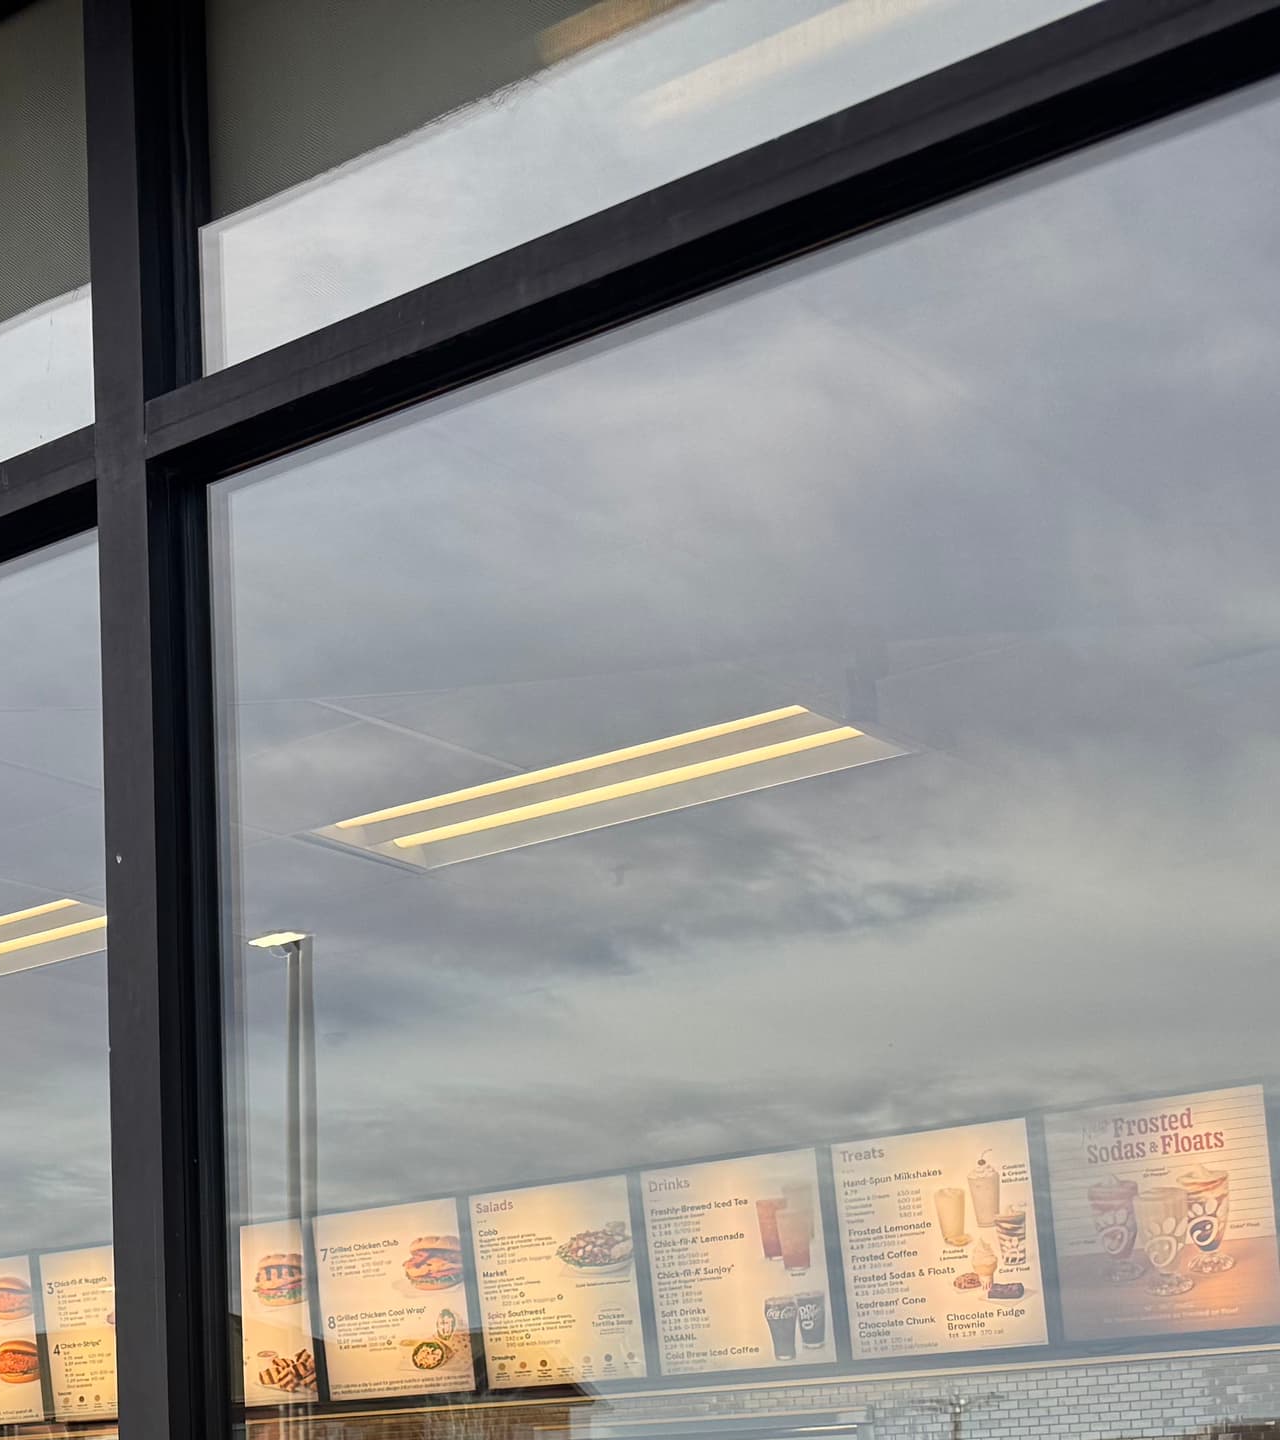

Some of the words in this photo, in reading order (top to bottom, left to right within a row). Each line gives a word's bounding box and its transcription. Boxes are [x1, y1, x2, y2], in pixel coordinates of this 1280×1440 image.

[1112, 1107, 1193, 1138] Frosted
[1088, 1142, 1146, 1164] Sodas
[1150, 1142, 1159, 1153] &
[1160, 1131, 1225, 1155] Floats
[840, 1148, 885, 1163] Treats
[648, 1178, 690, 1192] Drinks
[843, 1176, 892, 1188] Hand-Spun
[894, 1168, 942, 1180] Milkshakes
[476, 1200, 514, 1214] Salads
[650, 1203, 712, 1216] Freshly-Brewed
[714, 1199, 732, 1209] Iced
[734, 1198, 748, 1206] Tea
[479, 1229, 498, 1237] Cobb
[849, 1226, 881, 1237] Frosted
[885, 1221, 932, 1233] Lemonade
[700, 1231, 744, 1243] Lemonade
[320, 1248, 328, 1262] 7
[329, 1245, 352, 1254] Grilled
[353, 1242, 382, 1251] Chicken
[383, 1240, 399, 1249] Club
[851, 1253, 885, 1263] Frosted
[887, 1249, 918, 1260] Coffee
[483, 1270, 507, 1278] Market
[853, 1273, 887, 1283] Frosted
[889, 1271, 916, 1280] Sodas
[919, 1269, 925, 1277] &
[928, 1266, 956, 1276] Floats
[47, 1282, 54, 1295] 3
[84, 1275, 107, 1284] Nuggets
[902, 1296, 926, 1305] Cone
[328, 1316, 336, 1329] 8
[337, 1313, 359, 1322] Grilled
[360, 1310, 388, 1320] Chicken
[389, 1308, 404, 1317] Cool
[406, 1306, 425, 1316] Wrap
[487, 1311, 506, 1320] Spicy
[508, 1307, 546, 1318] Southwest
[598, 1313, 625, 1321] Chicken
[661, 1310, 678, 1318] Soft
[680, 1308, 706, 1316] Drinks
[946, 1311, 994, 1322] Chocolate
[997, 1308, 1025, 1318] Fudge
[858, 1319, 904, 1330] Chocolate
[906, 1316, 936, 1326] Chunk
[947, 1320, 986, 1331] Brownie
[859, 1330, 890, 1339] Cookie
[53, 1343, 61, 1356] 4
[666, 1351, 684, 1360] Cold
[710, 1348, 728, 1356] Iced
[730, 1346, 760, 1355] Coffee
